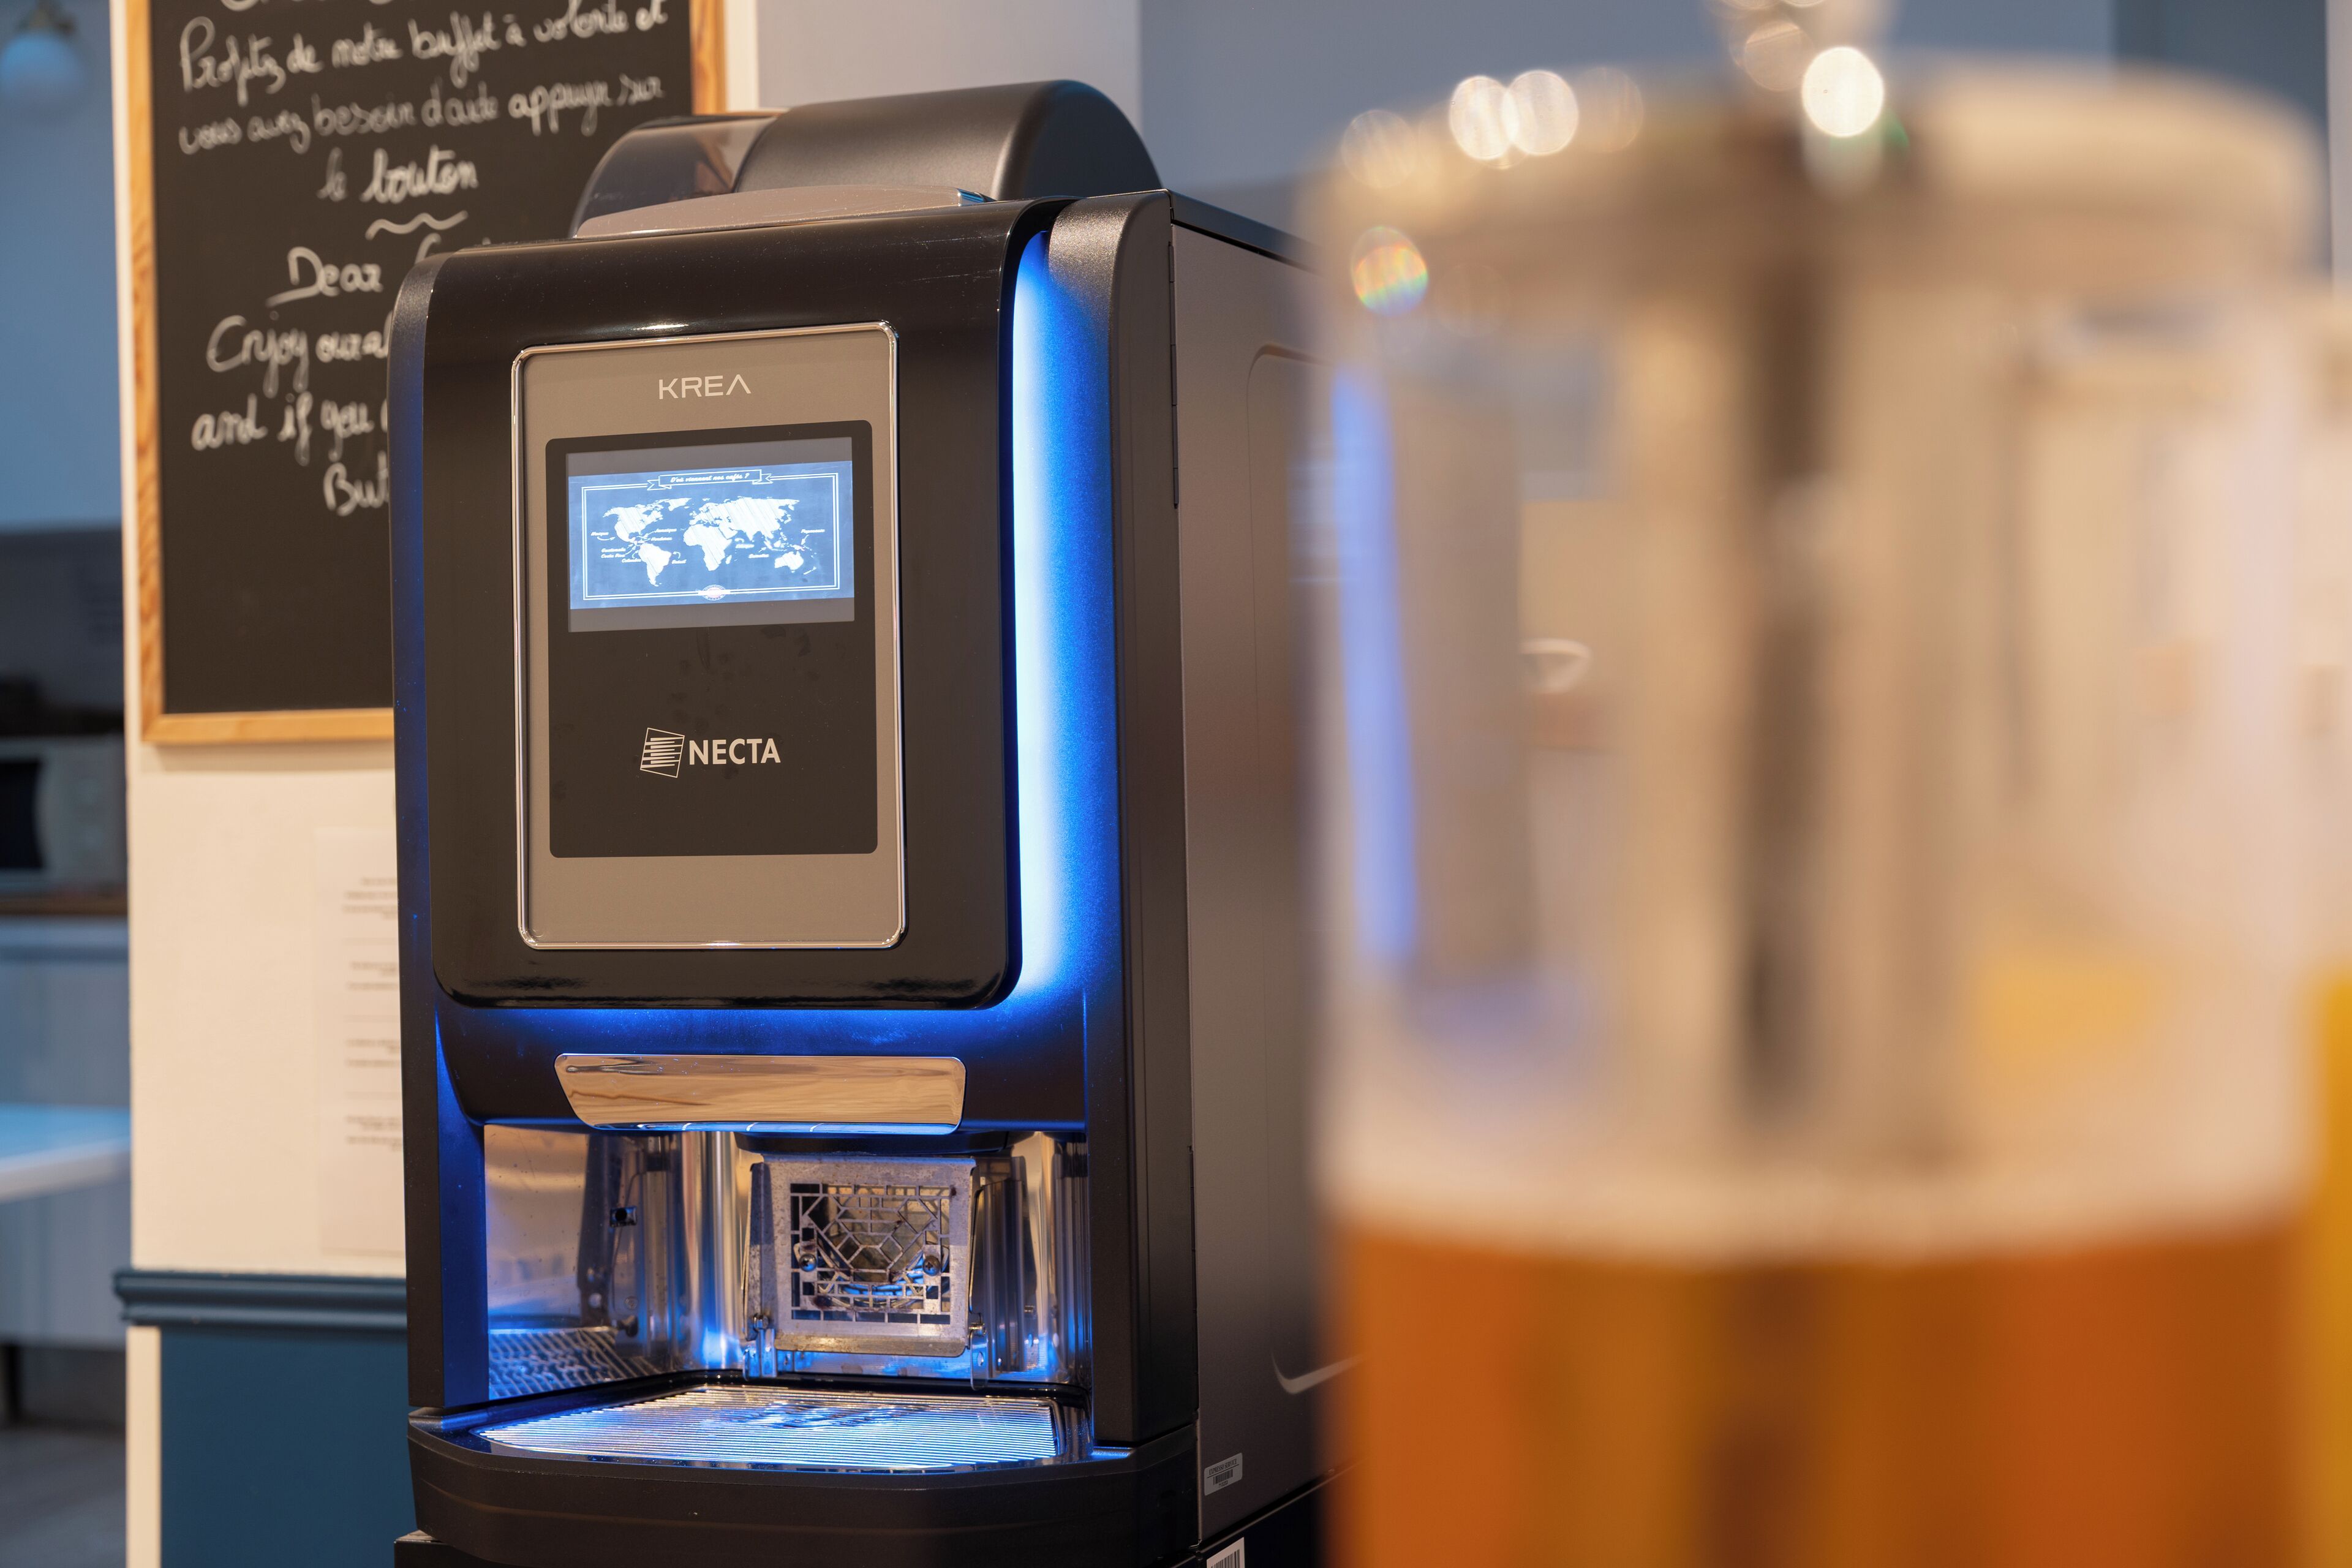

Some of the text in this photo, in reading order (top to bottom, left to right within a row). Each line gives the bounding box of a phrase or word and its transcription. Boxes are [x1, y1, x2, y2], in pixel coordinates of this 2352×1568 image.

[287, 33, 323, 74] de
[408, 10, 501, 88] buffet
[311, 92, 417, 137] besoin
[359, 144, 479, 204] bouton
[265, 246, 383, 307] Dear
[658, 374, 752, 400] KREA
[191, 393, 268, 451] and
[277, 391, 314, 466] if
[320, 399, 375, 462] you
[689, 738, 781, 765] NECTA
